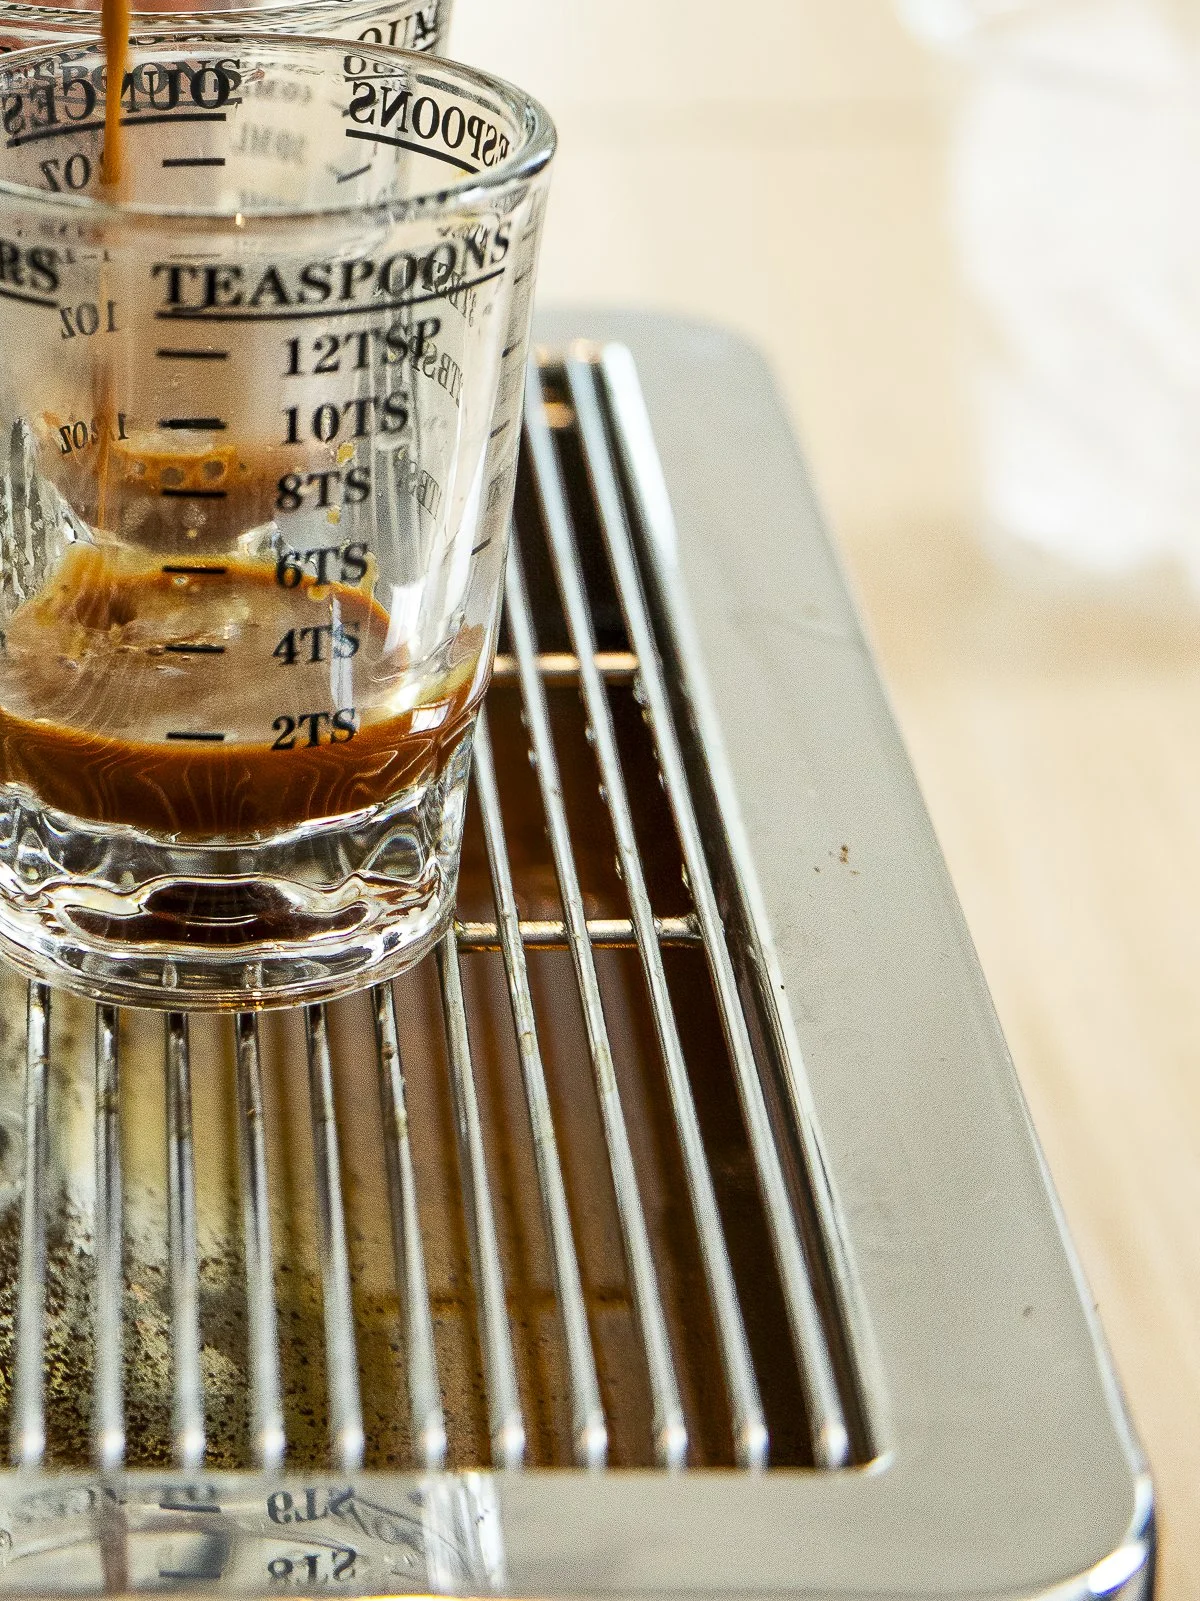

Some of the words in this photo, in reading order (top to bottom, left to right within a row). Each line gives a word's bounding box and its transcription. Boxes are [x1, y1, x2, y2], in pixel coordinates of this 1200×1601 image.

[150, 232, 511, 308] TEASPOONS
[280, 317, 442, 377] 12TSP
[281, 390, 409, 446] 10TS
[275, 465, 371, 511] 8TS
[276, 542, 368, 588] 6TS
[273, 621, 359, 666] 4TS
[271, 708, 358, 750] 2TS
